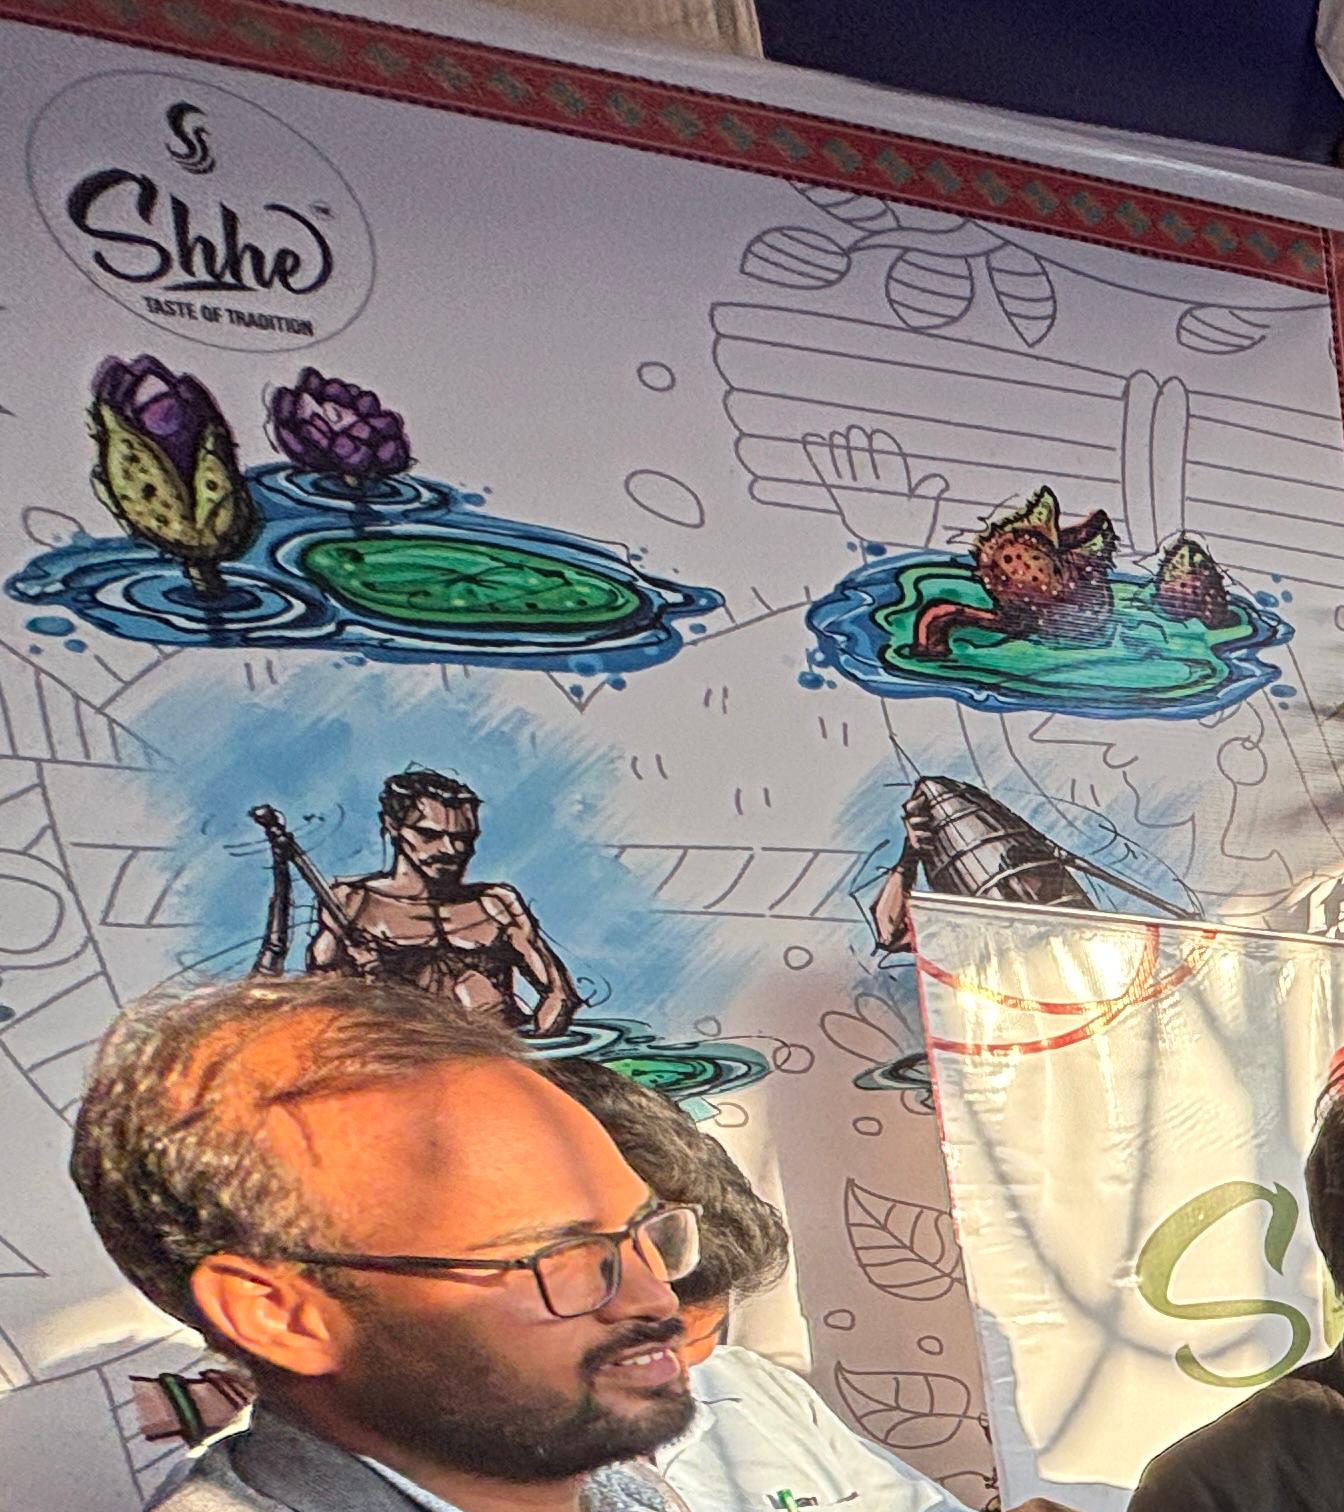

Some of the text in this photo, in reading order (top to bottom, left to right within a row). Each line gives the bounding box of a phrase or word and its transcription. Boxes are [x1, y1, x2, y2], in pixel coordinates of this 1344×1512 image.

[67, 167, 334, 295] Shhe
[143, 296, 315, 337] TASTE OF TRADITION
